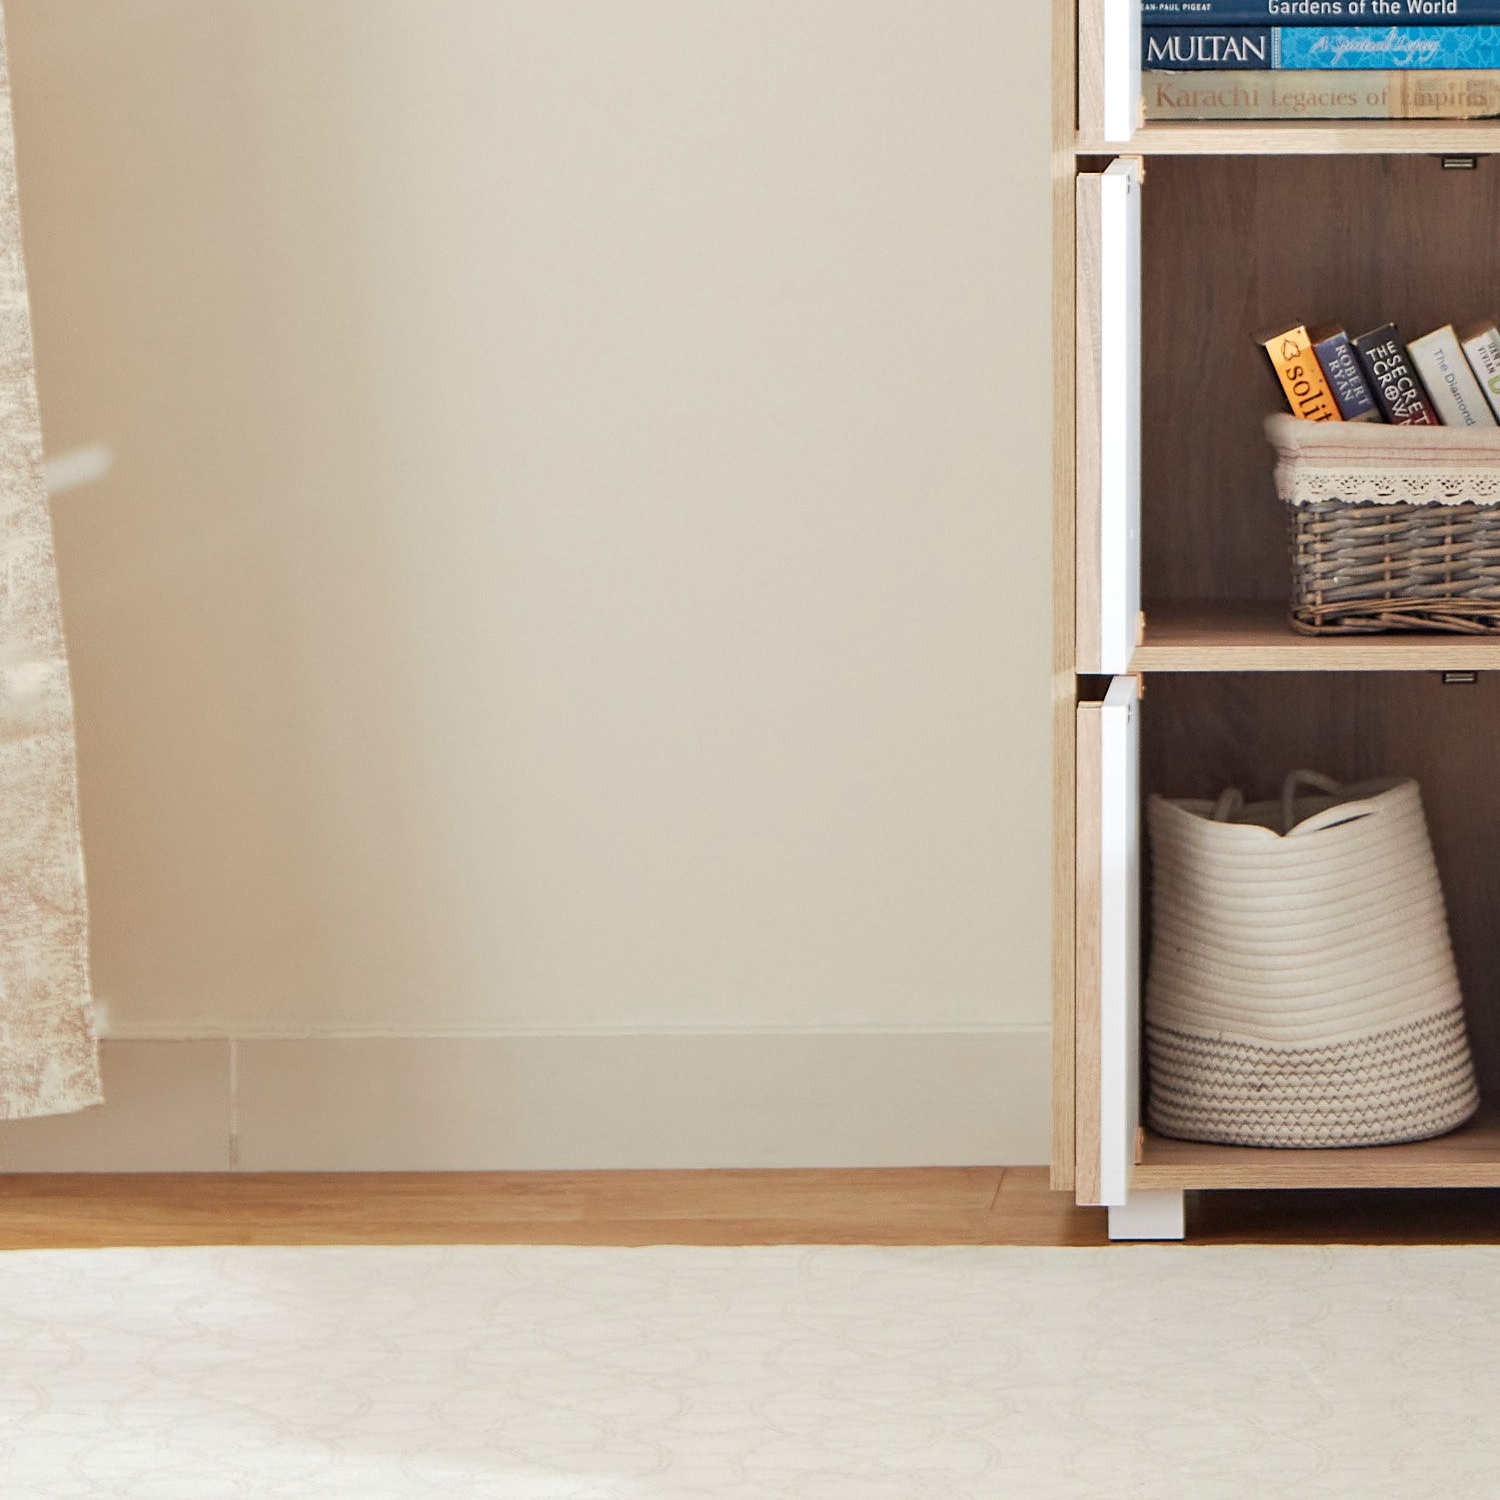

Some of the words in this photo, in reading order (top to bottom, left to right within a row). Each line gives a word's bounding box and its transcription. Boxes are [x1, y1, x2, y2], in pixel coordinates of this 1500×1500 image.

[1182, 3, 1211, 11] PIGEAT
[1147, 36, 1266, 61] MULTAN
[1310, 35, 1329, 53] A
[1155, 83, 1259, 107] Karachi
[1271, 88, 1357, 111] Legacies
[1366, 84, 1390, 105] of
[1365, 341, 1397, 362] THE
[1478, 345, 1496, 375] VIVIAN
[1328, 360, 1355, 402] RYAN
[1335, 344, 1370, 406] ROBERT
[1433, 348, 1449, 371] The
[1444, 372, 1476, 426] Diamond
[1387, 355, 1431, 425] SECRET
